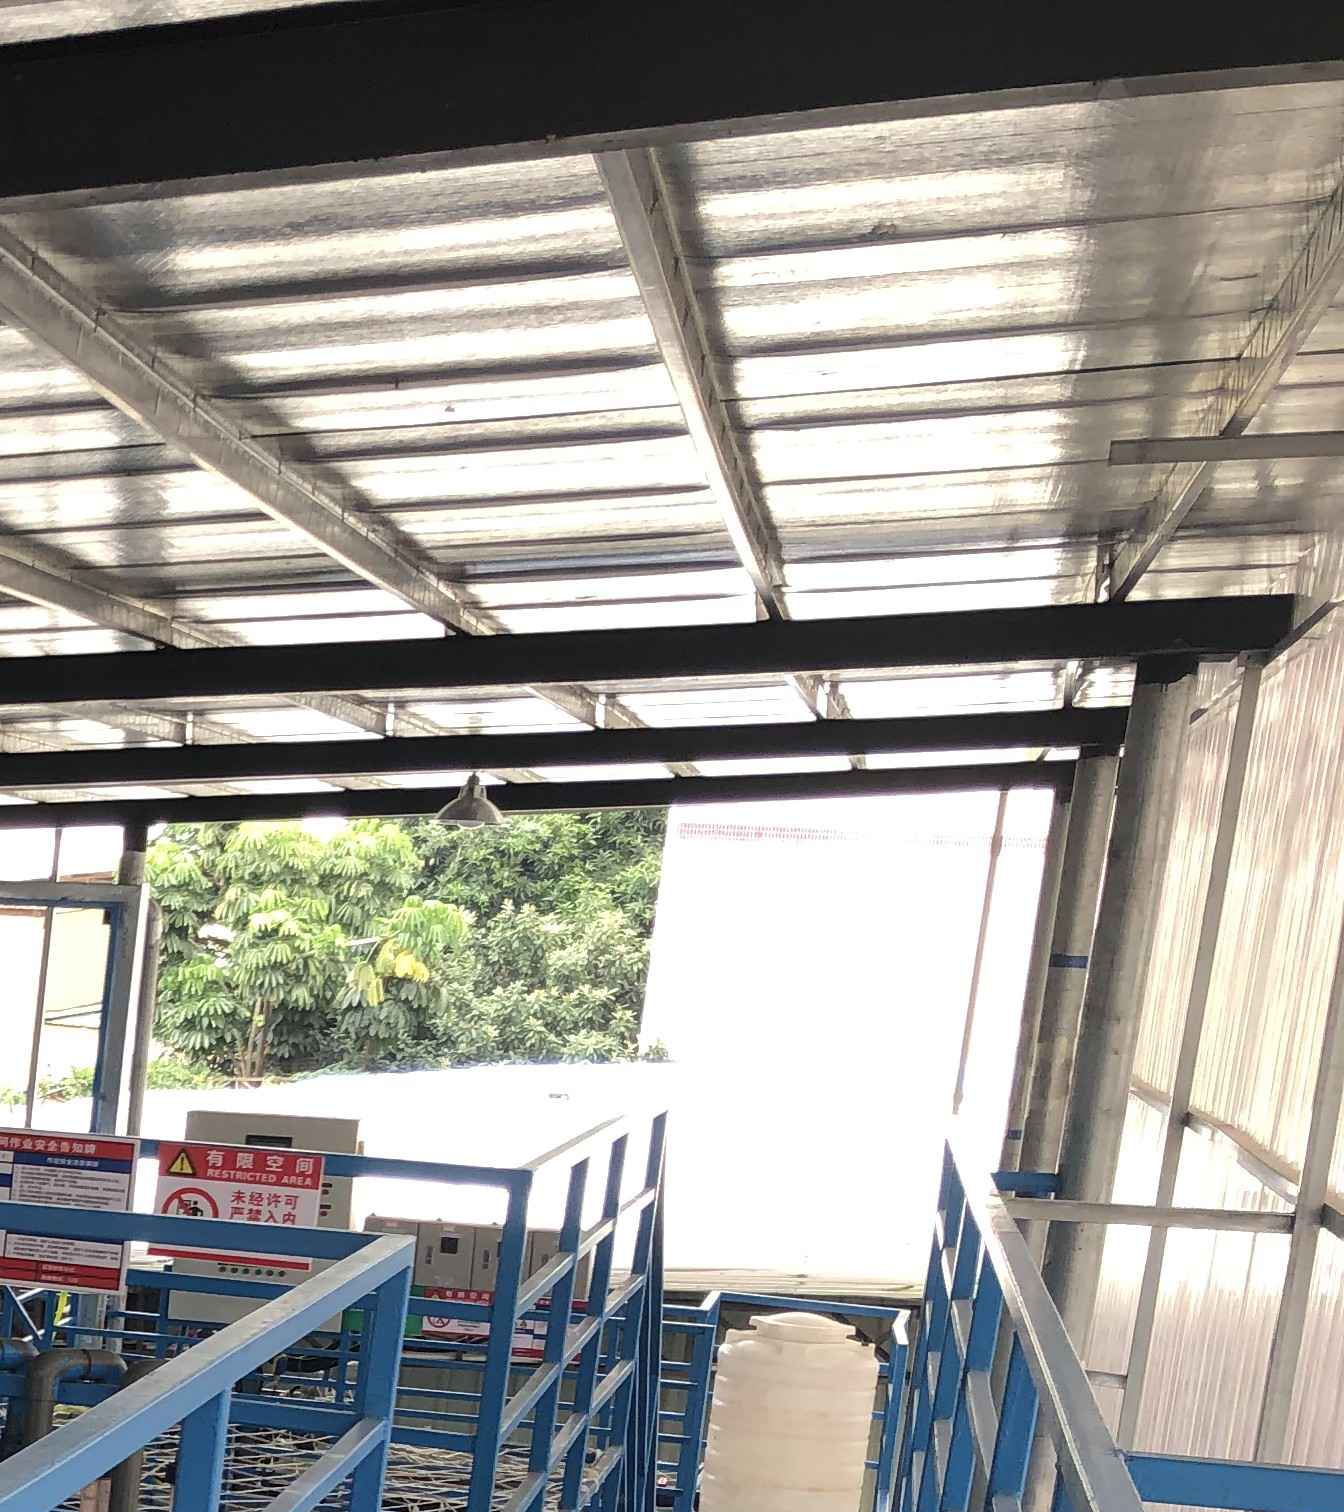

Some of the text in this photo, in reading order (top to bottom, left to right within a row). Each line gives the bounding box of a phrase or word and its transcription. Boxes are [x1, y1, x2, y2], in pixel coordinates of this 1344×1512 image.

[206, 1150, 314, 1175] 有限空间
[206, 1168, 312, 1187] RESTRICTED AREA
[230, 1190, 299, 1210] 未经许可
[228, 1206, 296, 1226] 严禁入内
